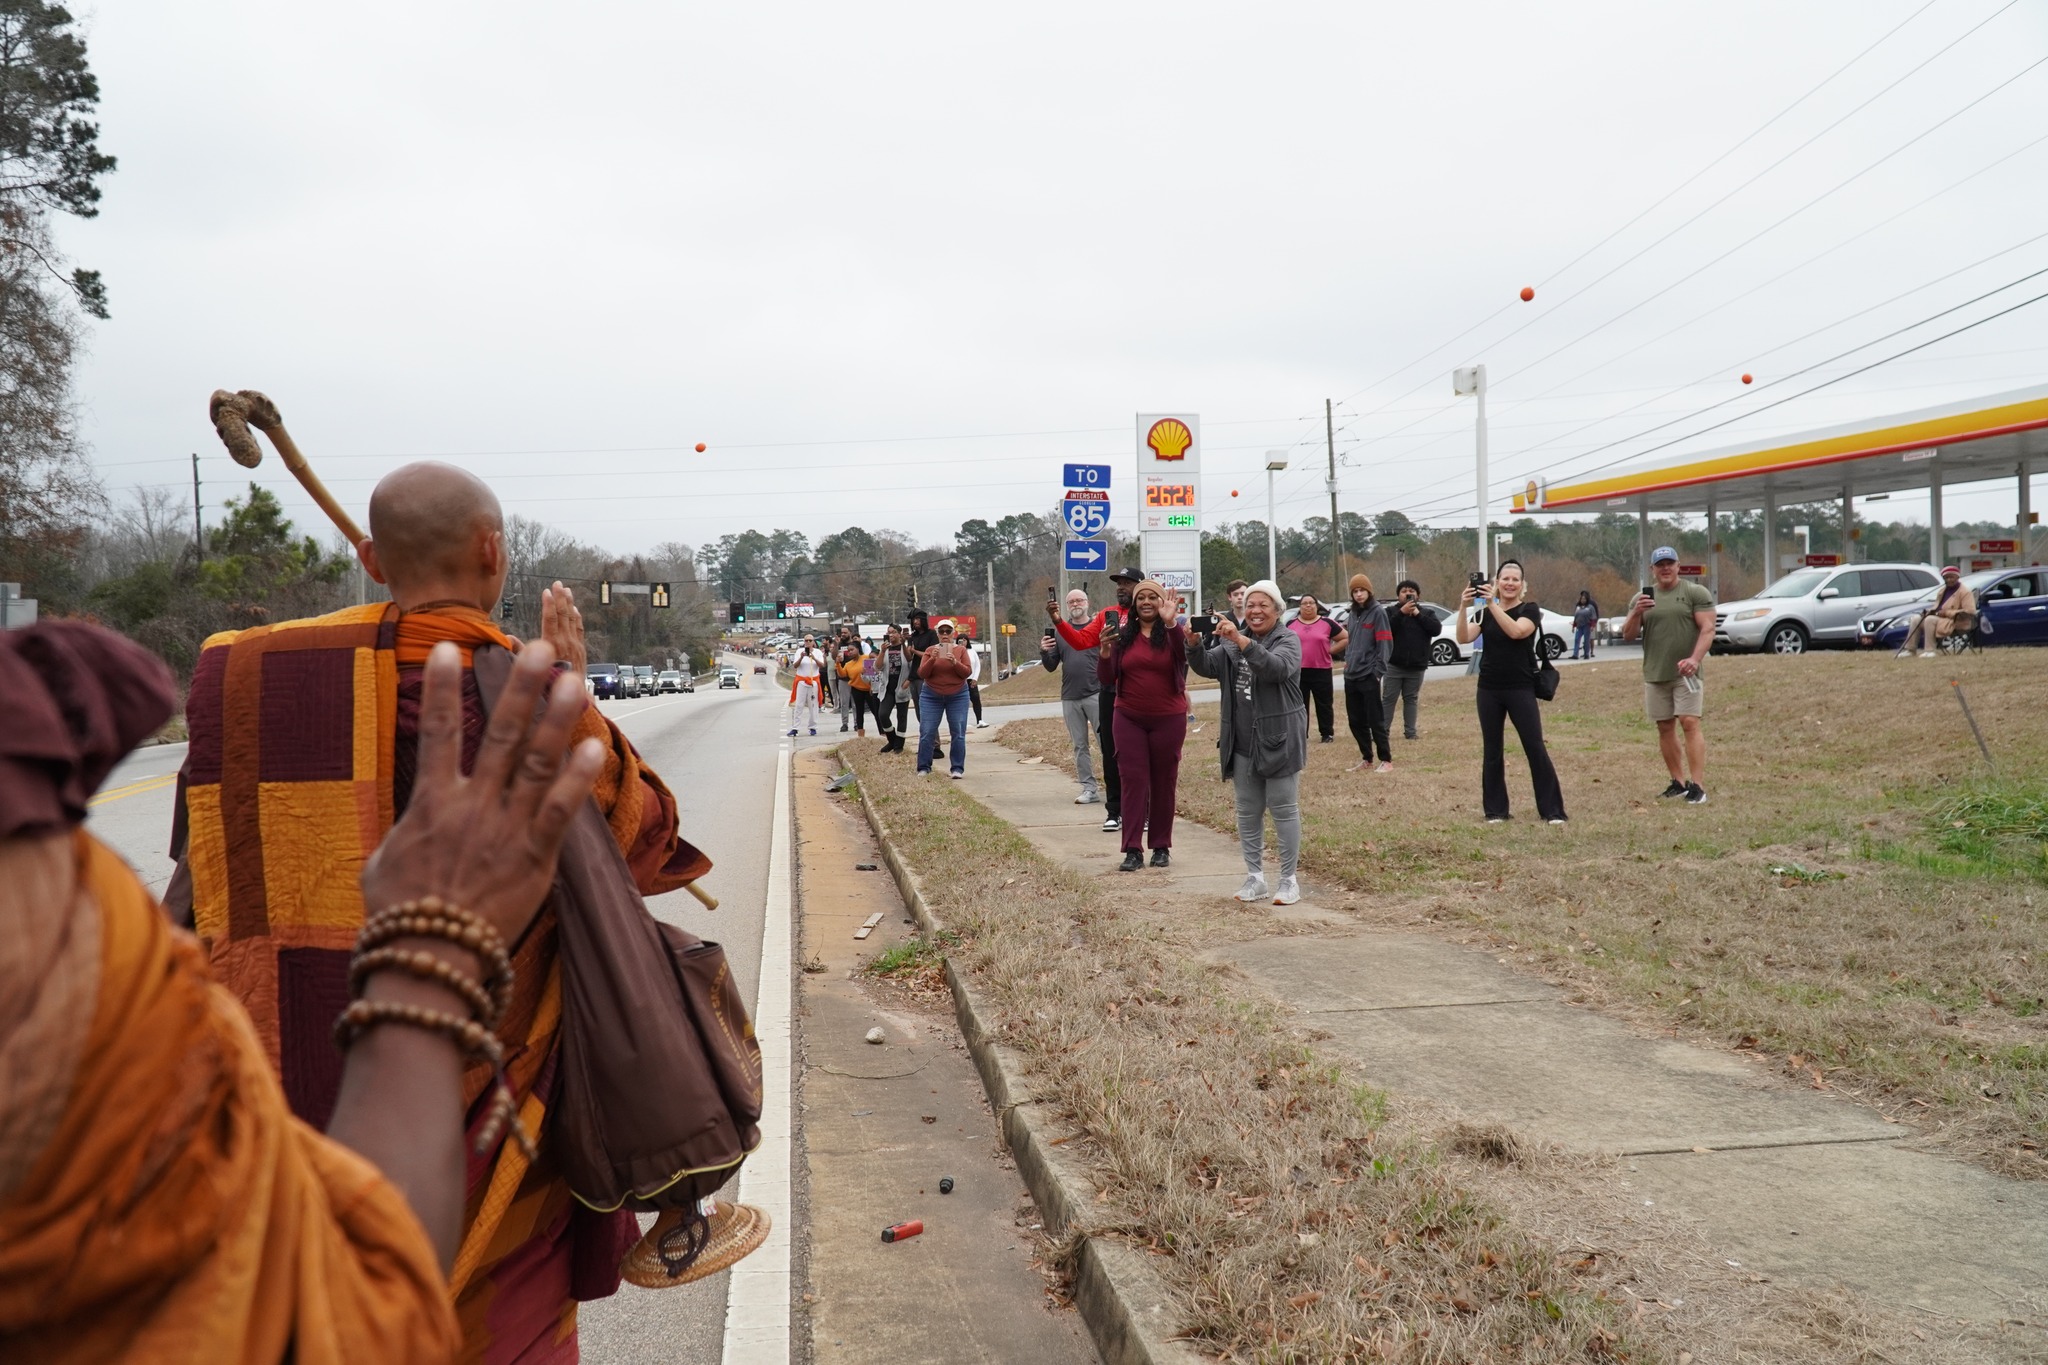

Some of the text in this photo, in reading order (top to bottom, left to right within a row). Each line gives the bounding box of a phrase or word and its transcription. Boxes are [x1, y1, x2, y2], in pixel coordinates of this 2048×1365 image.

[1075, 469, 1098, 483] TO
[1070, 492, 1104, 500] INTERSTATE
[1069, 505, 1105, 532] 85
